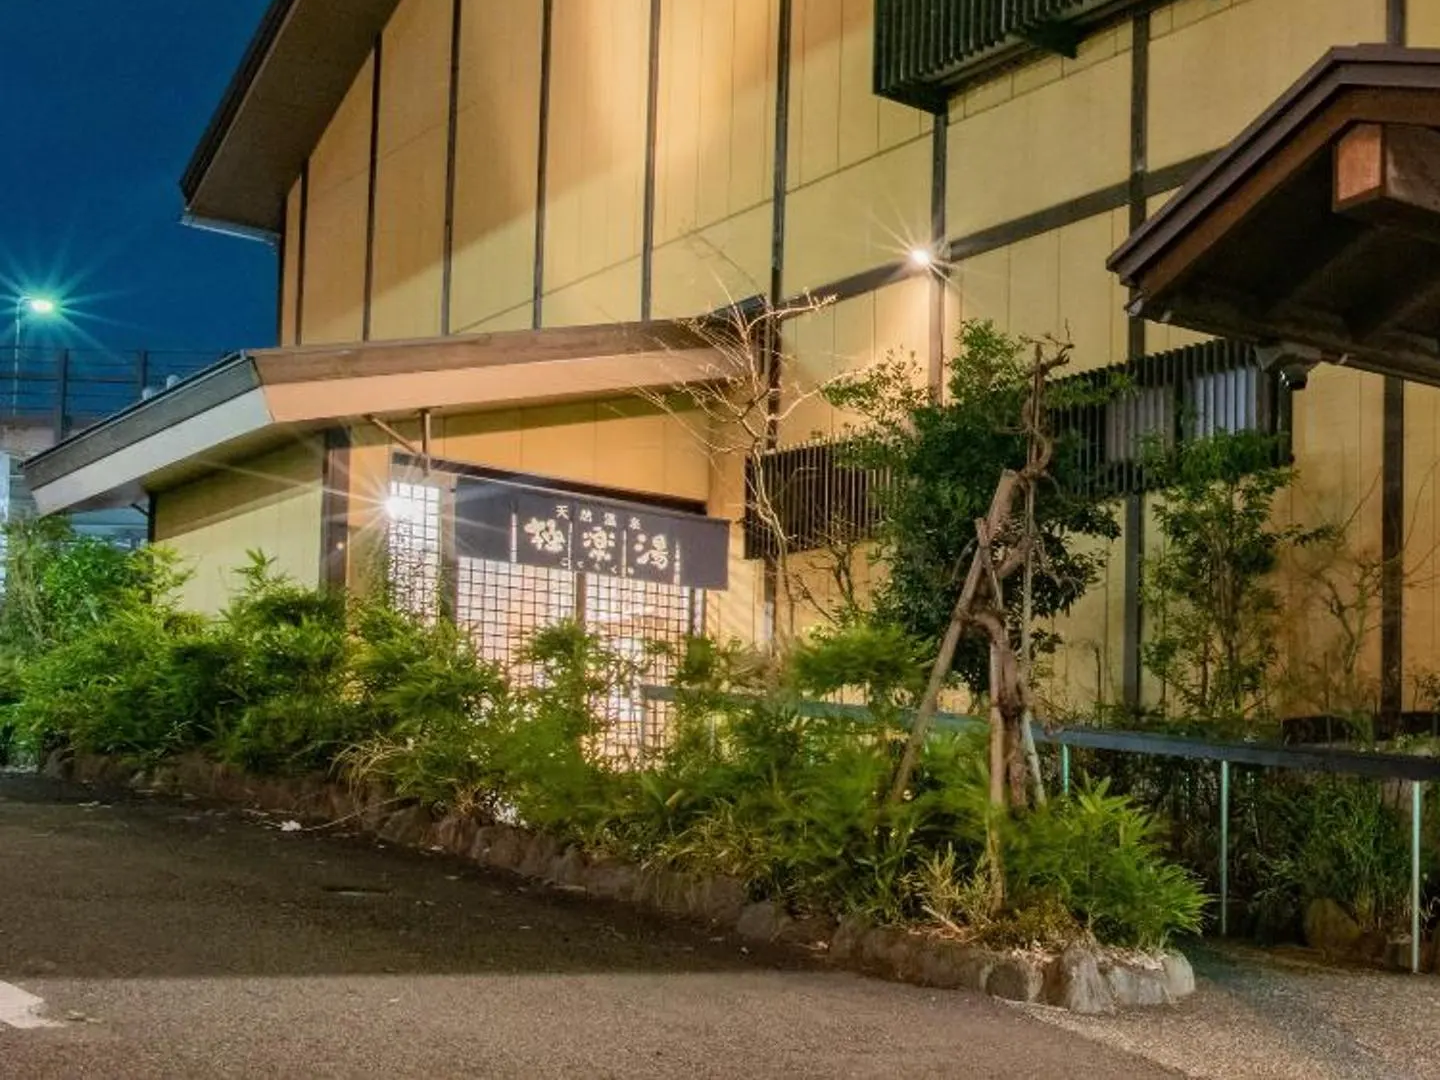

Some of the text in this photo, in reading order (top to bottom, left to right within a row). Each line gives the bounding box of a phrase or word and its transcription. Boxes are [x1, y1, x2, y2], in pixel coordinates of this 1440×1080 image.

[555, 504, 642, 531] 天然温泉
[524, 516, 669, 570] 極楽湯
